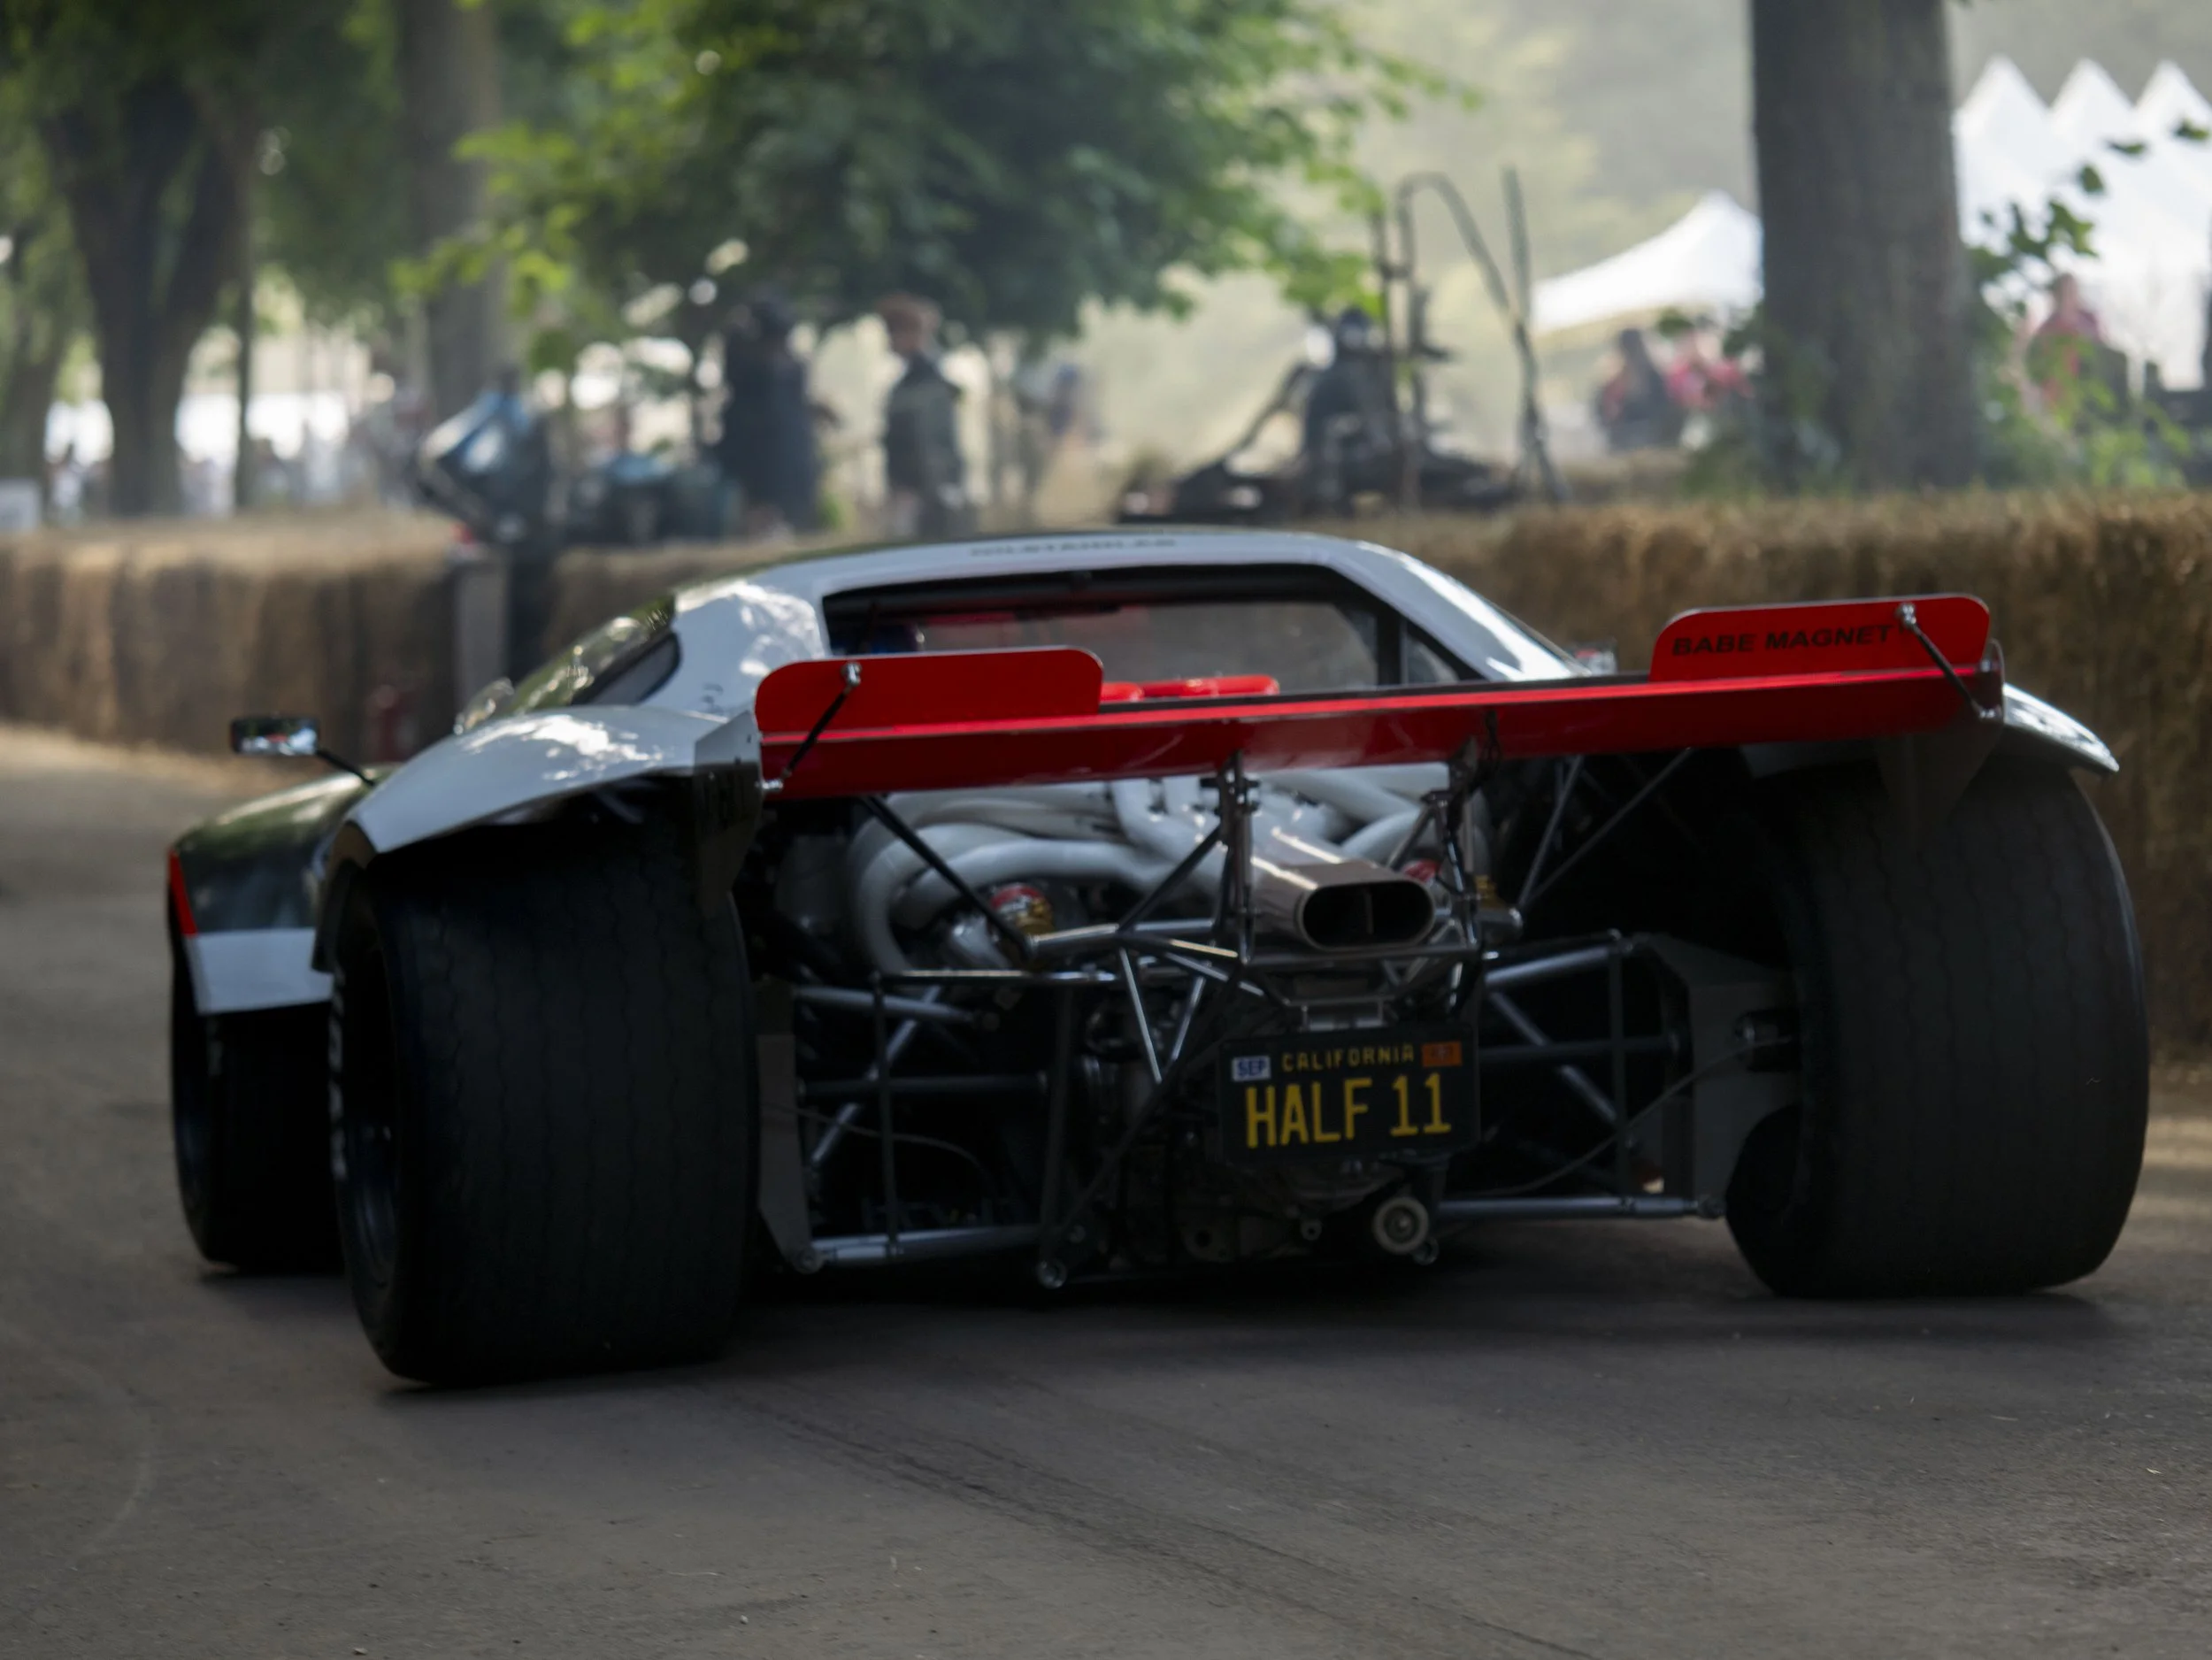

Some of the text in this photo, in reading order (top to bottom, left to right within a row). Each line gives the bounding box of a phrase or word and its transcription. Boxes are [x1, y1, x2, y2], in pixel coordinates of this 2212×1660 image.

[1673, 625, 1892, 657] BABE MAGNET
[1238, 1058, 1266, 1077] SEP
[1282, 1043, 1414, 1072] CALIFORNIA
[1246, 1072, 1452, 1149] HALF 11
